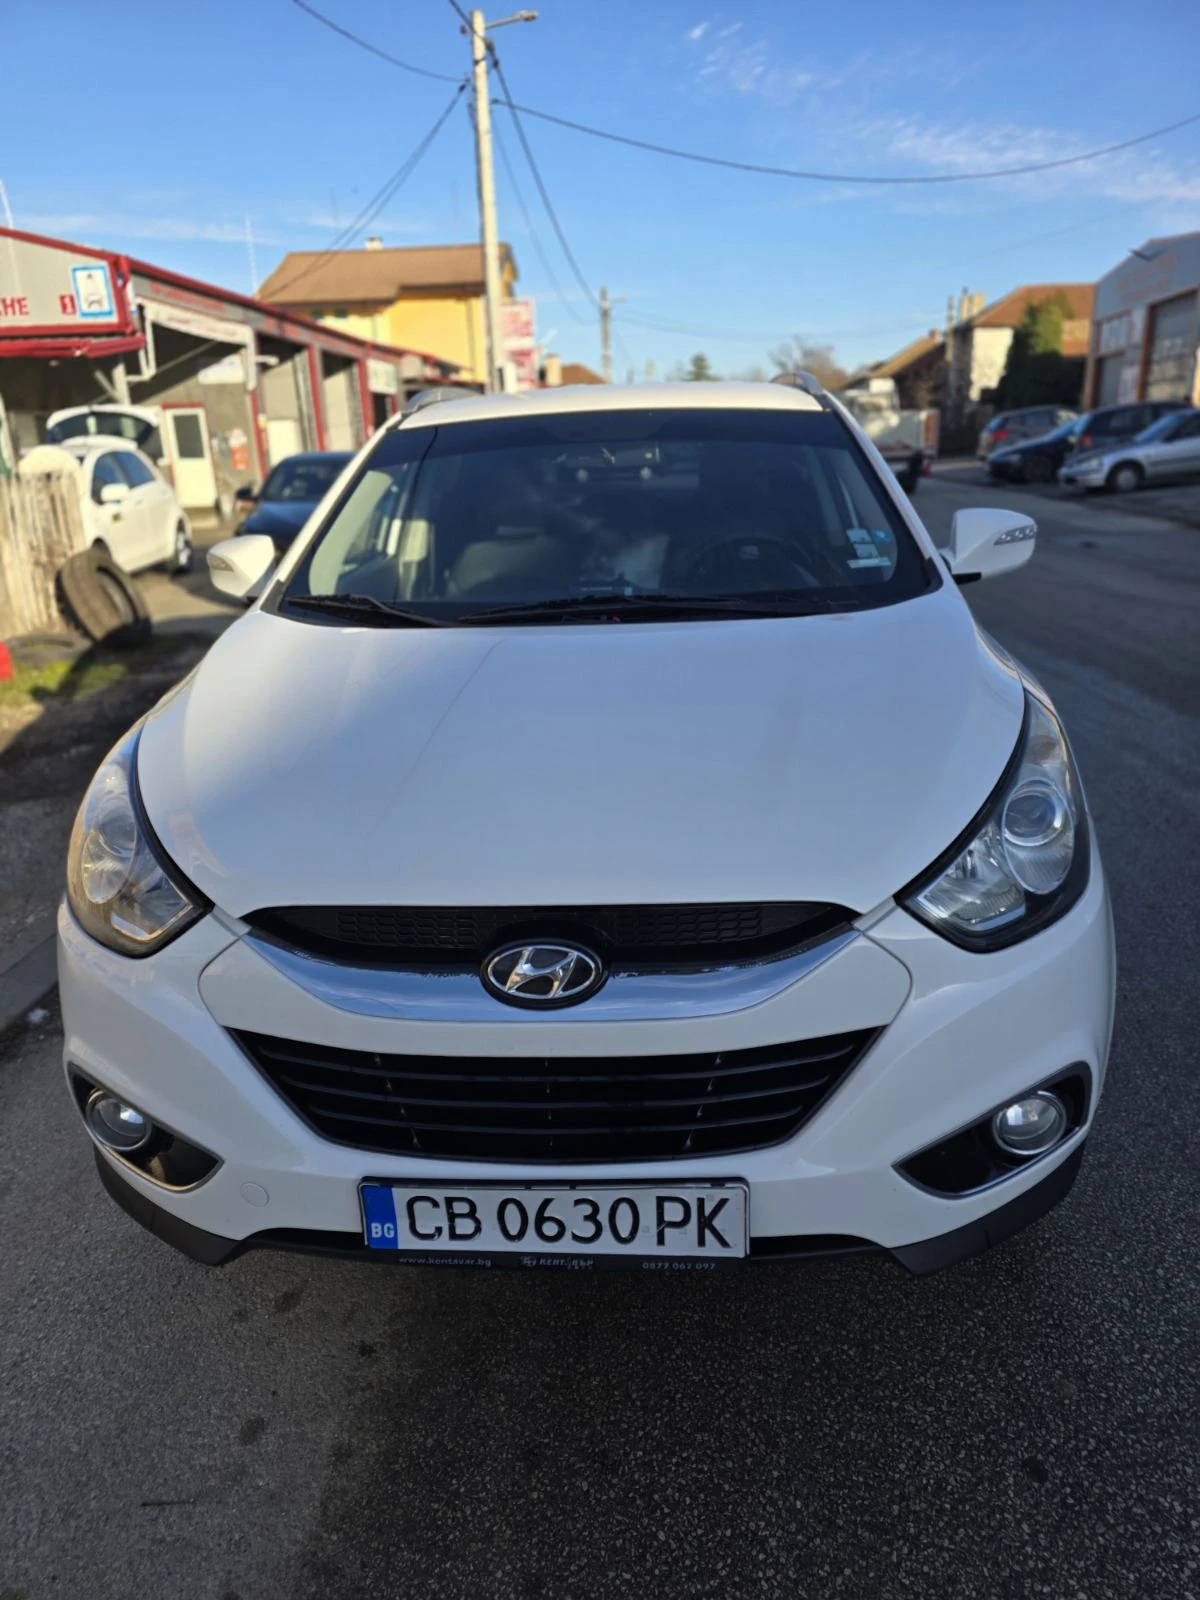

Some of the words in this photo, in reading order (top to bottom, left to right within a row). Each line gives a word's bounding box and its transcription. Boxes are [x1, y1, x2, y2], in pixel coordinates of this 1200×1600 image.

[371, 1222, 395, 1238] BG
[406, 1195, 482, 1242] CB
[496, 1197, 640, 1245] 0630
[655, 1195, 733, 1248] PK
